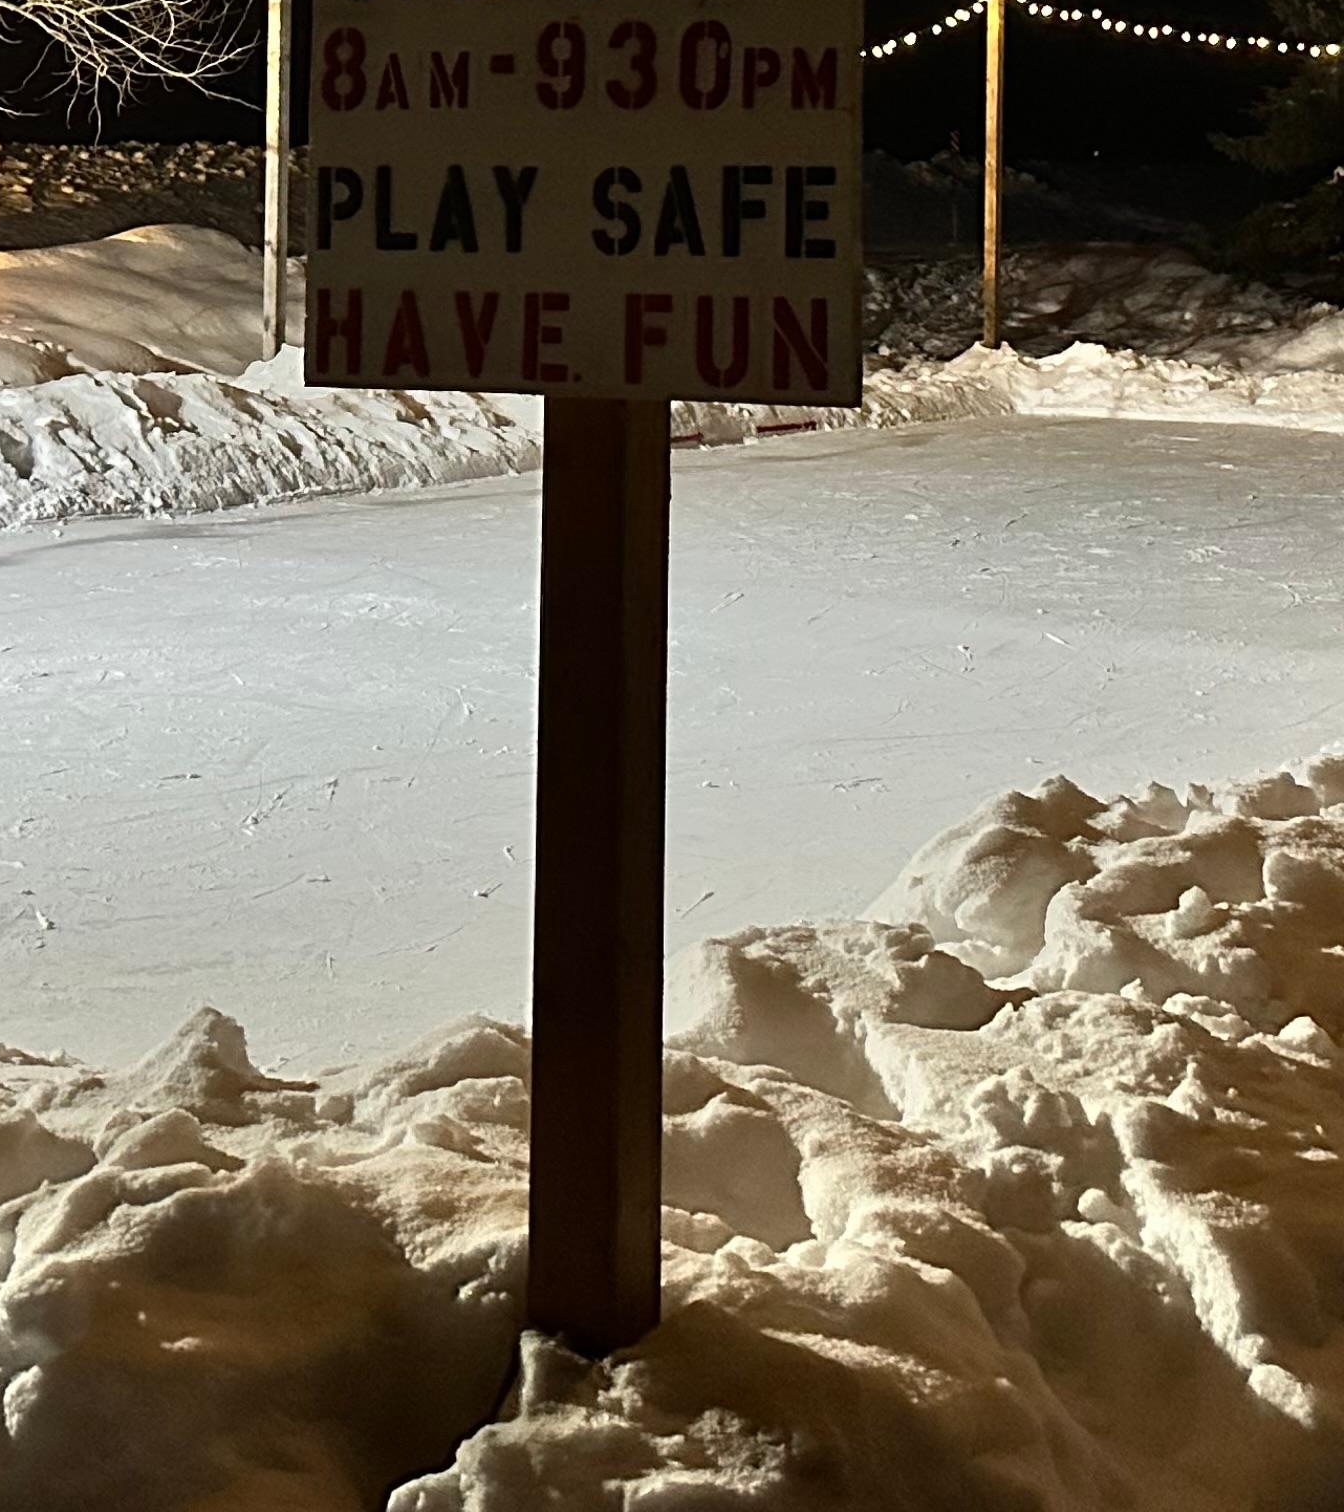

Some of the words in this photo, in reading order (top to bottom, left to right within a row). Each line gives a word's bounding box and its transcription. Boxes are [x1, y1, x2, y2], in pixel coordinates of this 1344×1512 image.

[317, 165, 538, 254] PLAY
[591, 165, 836, 259] SAFE
[623, 294, 829, 391] FUN
